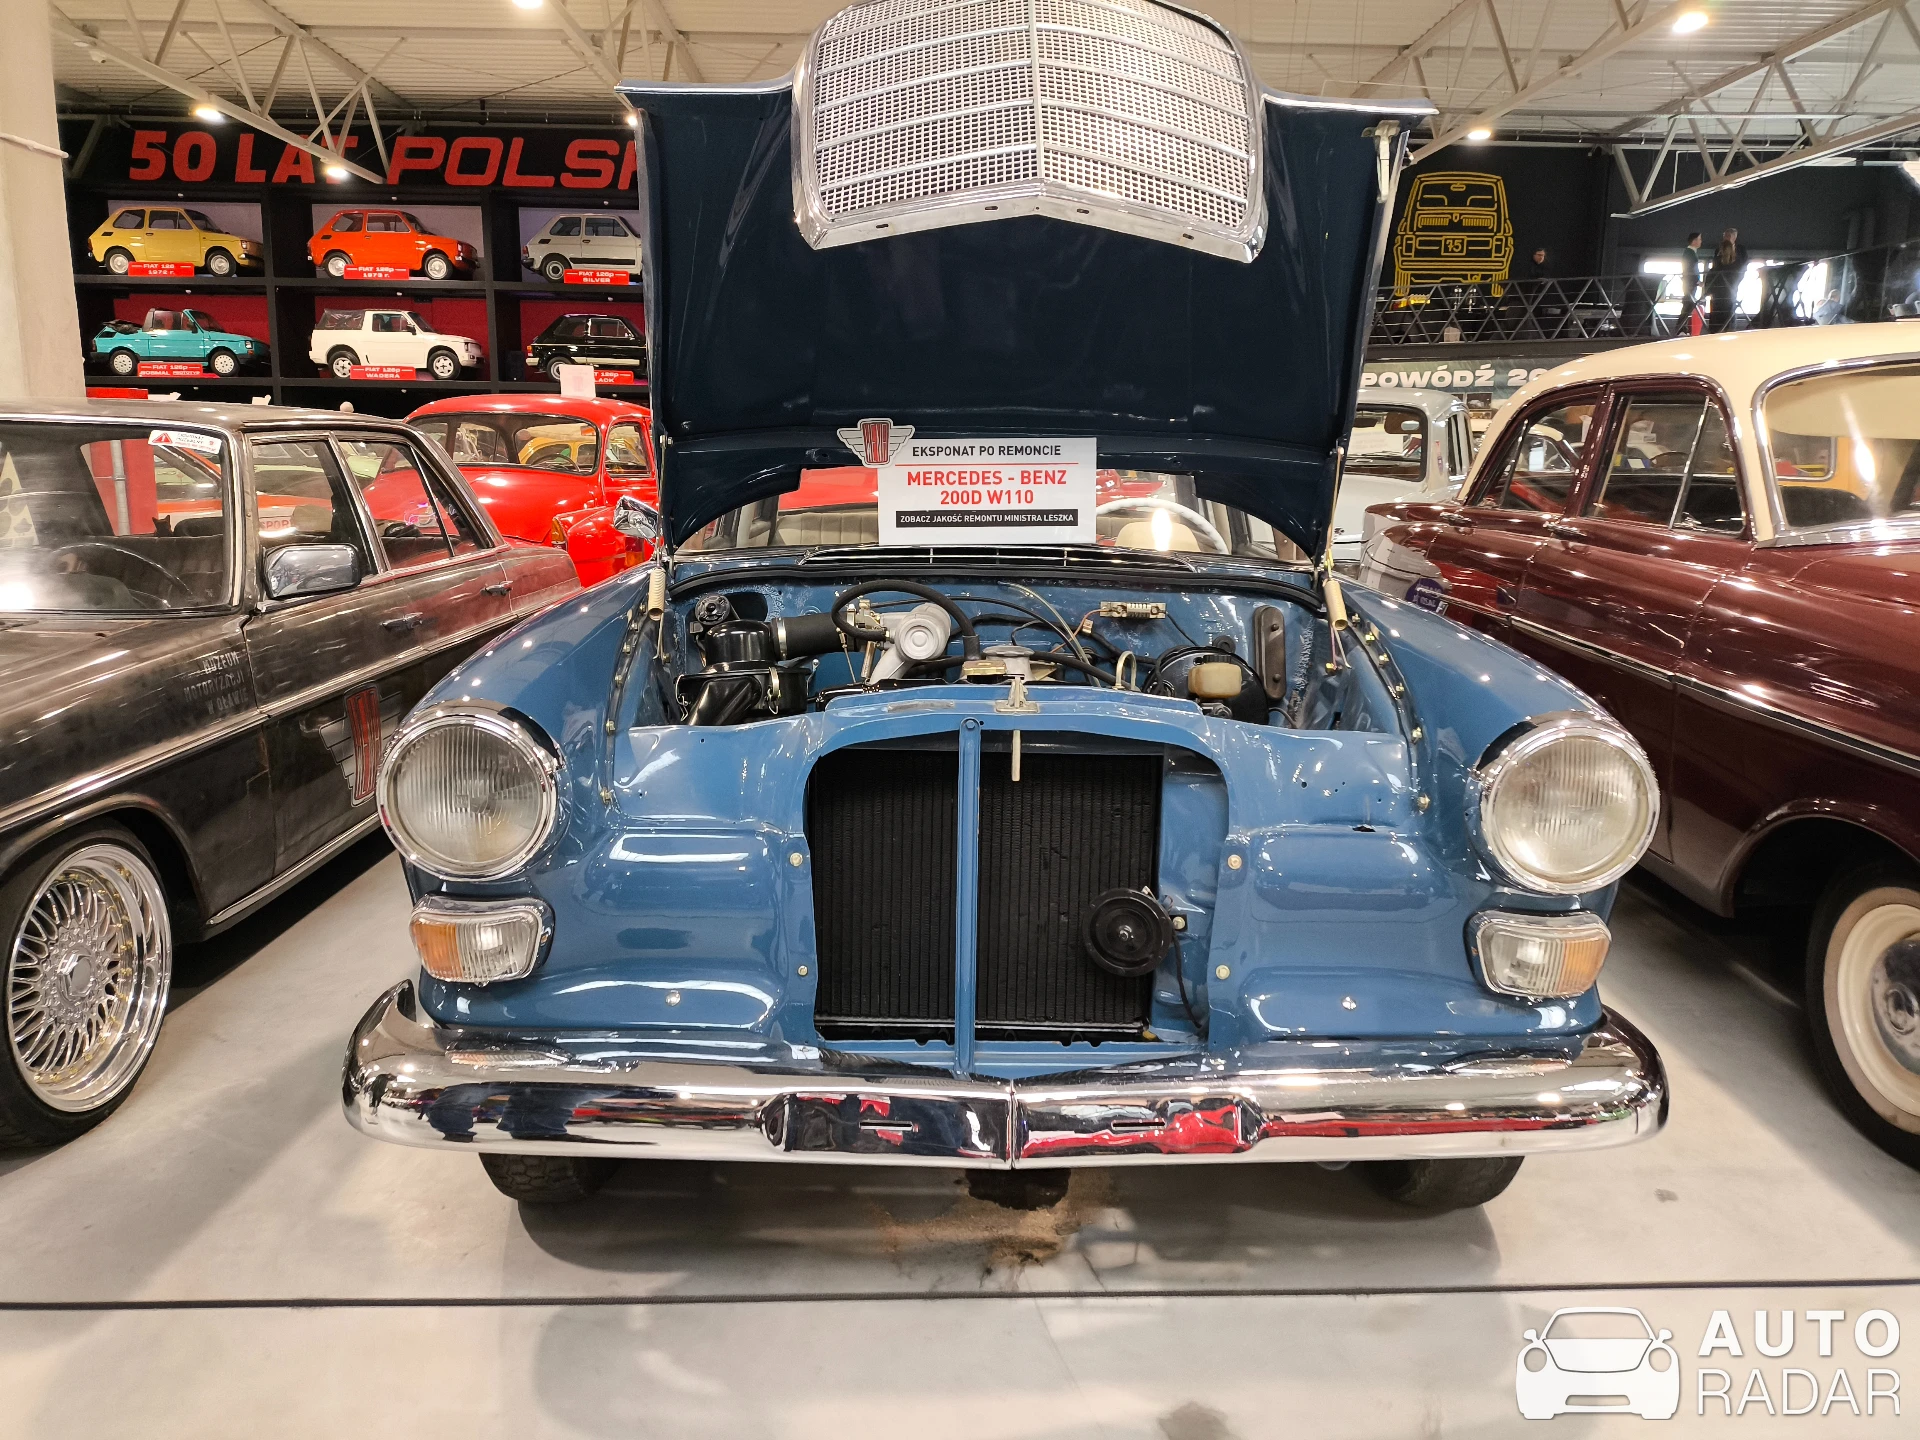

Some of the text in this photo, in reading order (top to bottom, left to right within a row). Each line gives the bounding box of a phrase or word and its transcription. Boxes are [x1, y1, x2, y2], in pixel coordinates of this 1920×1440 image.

[129, 129, 217, 182] 50
[1445, 239, 1462, 252] 75
[1360, 364, 1496, 388] POWÓDŹ
[912, 445, 1061, 457] EKSPONAT PO REMONCIE
[907, 470, 1003, 486] MERCEDES
[1020, 470, 1067, 485] BENZ
[940, 490, 1034, 505] 200D W110
[900, 513, 1074, 523] ZOBACZ JAKOŚĆ REMONTU MINISTRA LESZKA
[203, 651, 240, 672] MUZEUM
[184, 670, 244, 702] MOTORYZACJI
[206, 688, 248, 714] W OŁAWIE
